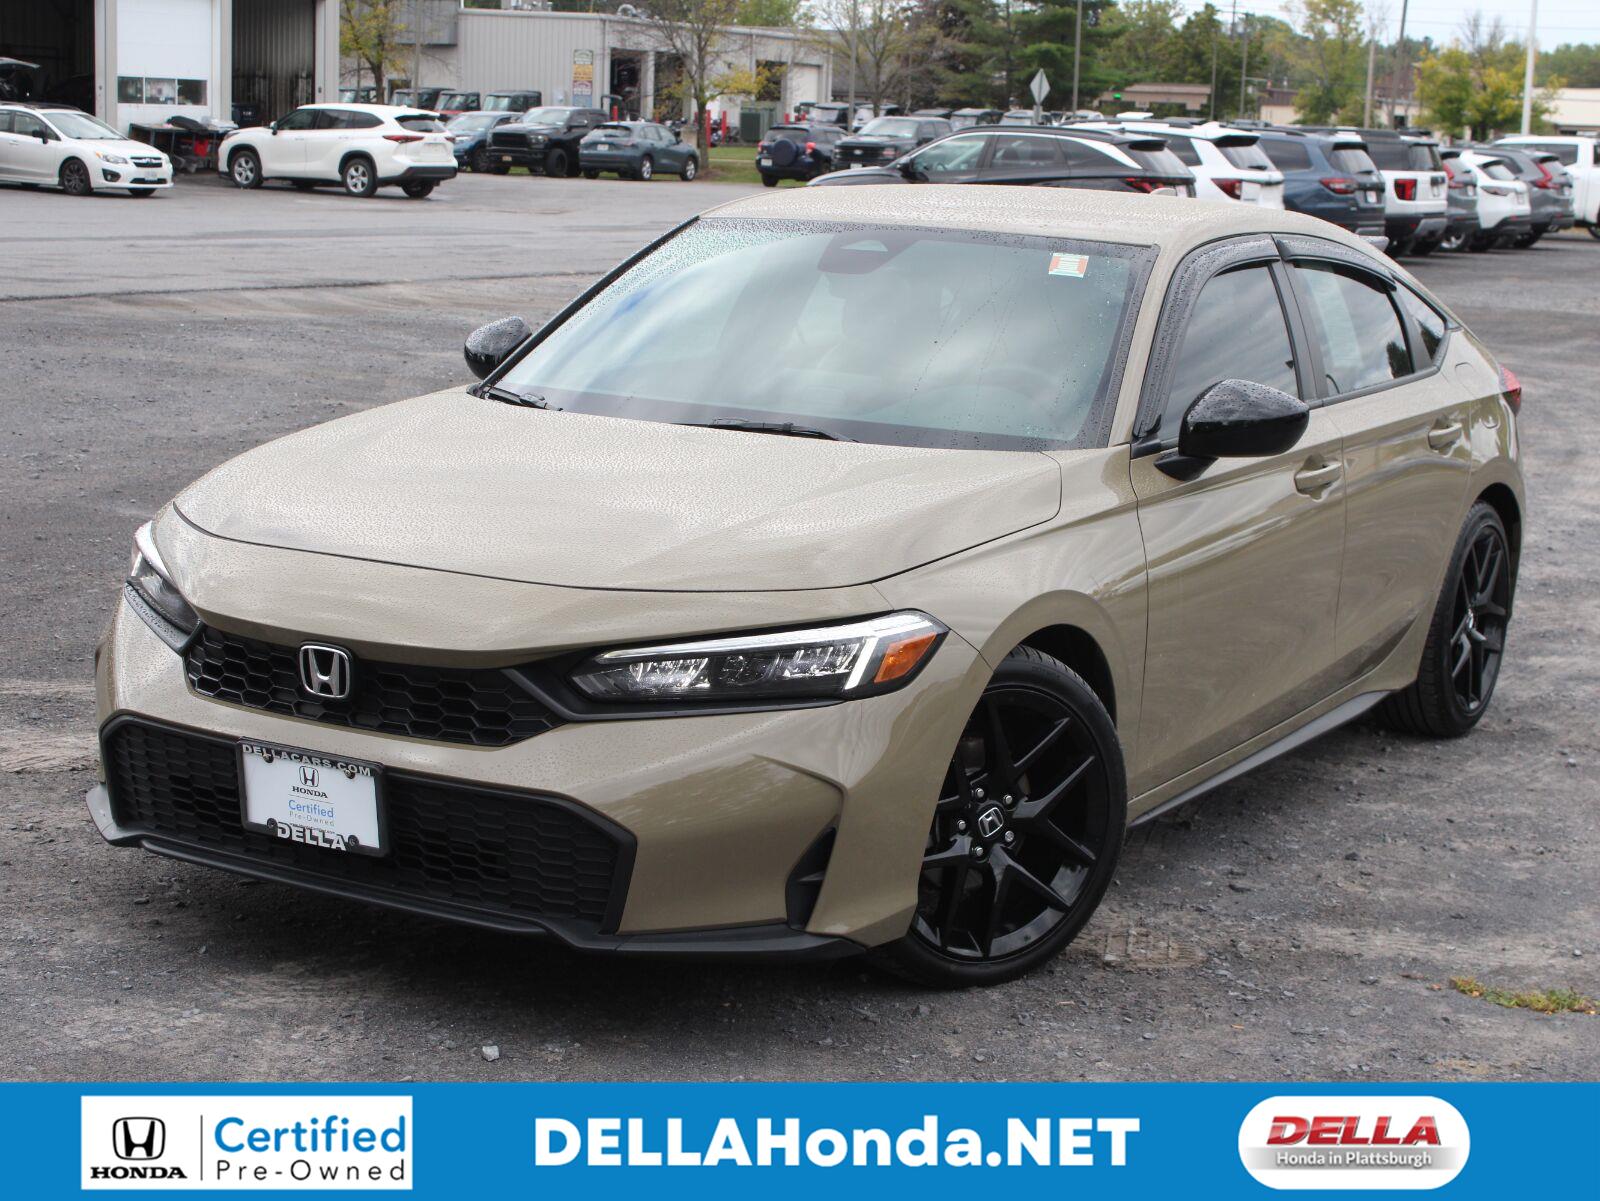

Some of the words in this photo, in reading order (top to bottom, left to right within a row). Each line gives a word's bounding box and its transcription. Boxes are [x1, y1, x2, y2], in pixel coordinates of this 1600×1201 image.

[242, 744, 371, 776] DELLACARS.COM
[292, 786, 328, 799] HONDA
[288, 799, 334, 818] Certified
[289, 811, 335, 827] Pre-Owned
[277, 822, 346, 851] DELLA
